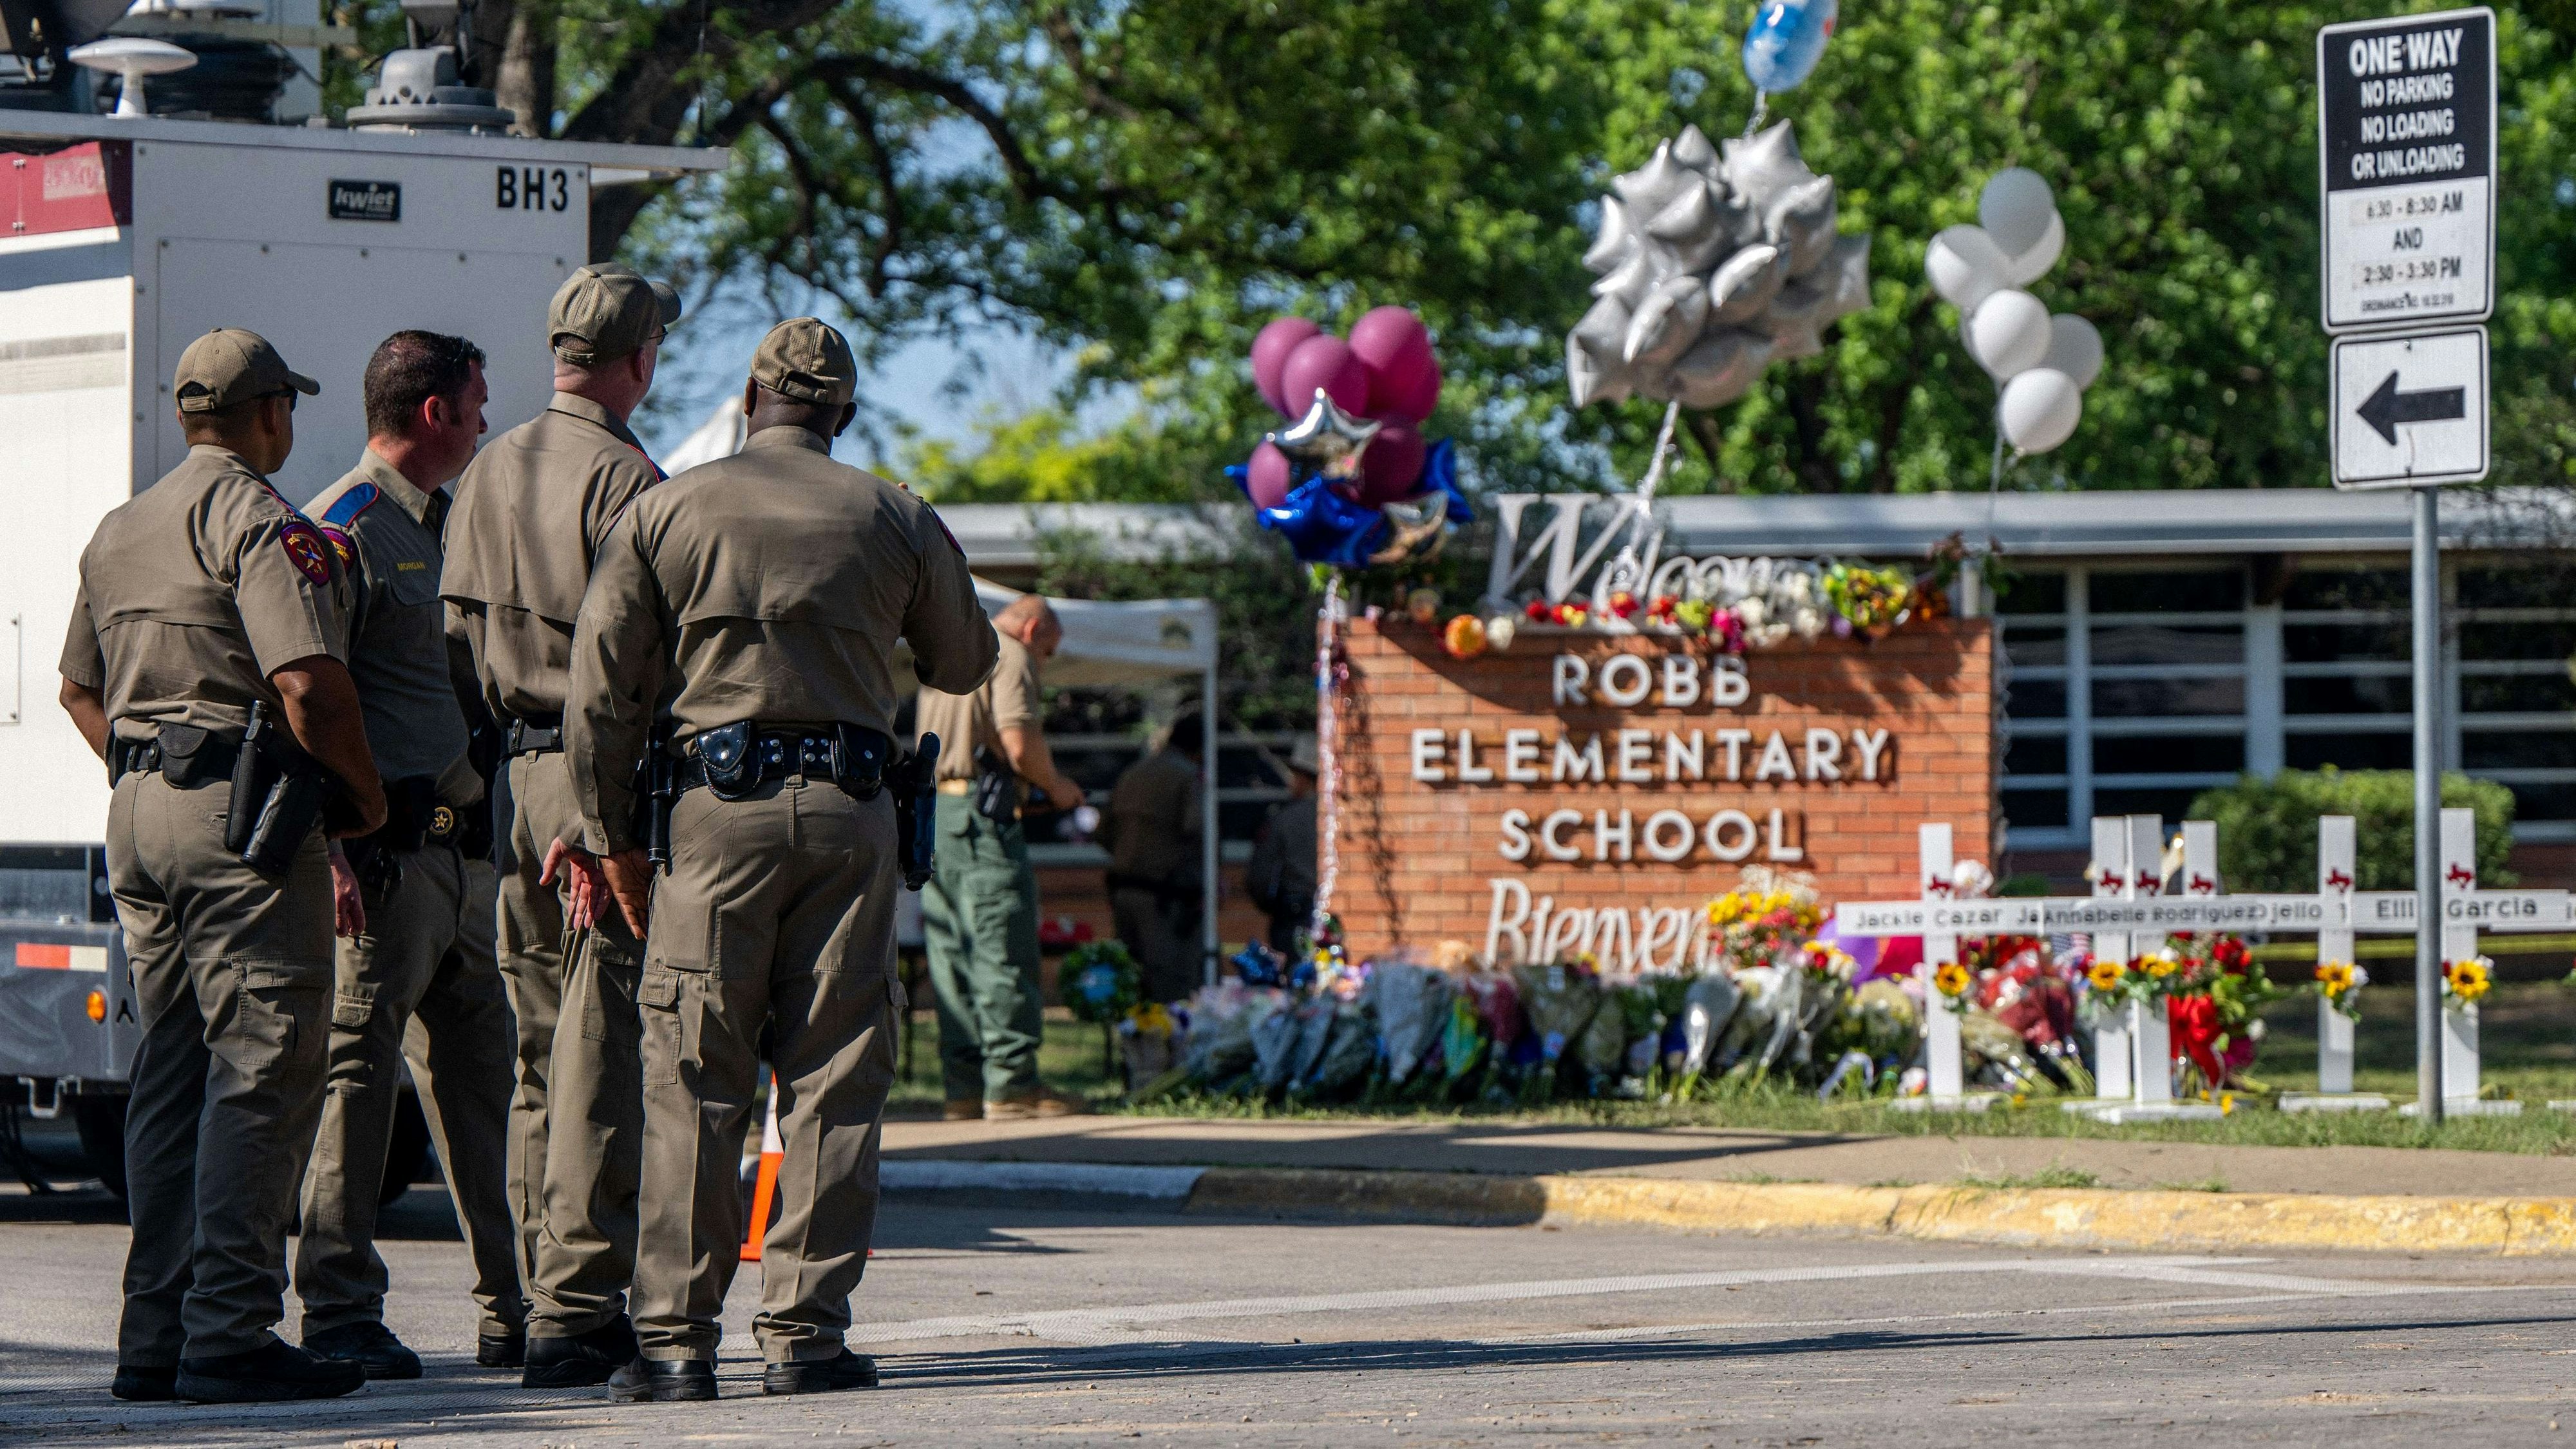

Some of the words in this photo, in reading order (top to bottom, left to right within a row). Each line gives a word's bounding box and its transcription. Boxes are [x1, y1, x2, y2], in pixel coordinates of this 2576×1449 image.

[2349, 35, 2403, 77] ONE
[2406, 28, 2463, 71] WAY
[2360, 80, 2385, 108] NO
[2386, 72, 2454, 105] PARKING
[2360, 115, 2385, 144] NO
[2386, 108, 2455, 142] LOADING
[2351, 152, 2376, 180] OR
[2376, 143, 2465, 178] UNLOADING
[335, 182, 395, 211] kwiet
[497, 166, 568, 212] BH3
[2405, 195, 2437, 216] 8:30
[2440, 189, 2463, 214] AM
[2392, 226, 2423, 251] AND
[2364, 263, 2394, 284] 2:30
[2407, 260, 2437, 279] 3:30
[2440, 256, 2461, 279] PM
[397, 561, 426, 572] MORGAN
[1552, 654, 1750, 707] ROBB
[1411, 728, 1890, 782] ELEMENTARY
[1498, 808, 1803, 862] SCHOOL
[1856, 909, 1924, 929] Jackie
[1934, 907, 2003, 927] Cazar
[2043, 907, 2146, 924] Annabelle
[2152, 904, 2257, 923] Rodriguez
[2376, 898, 2415, 919] Elli
[2447, 896, 2537, 919] Garcia
[1489, 877, 1718, 985] Bienven
